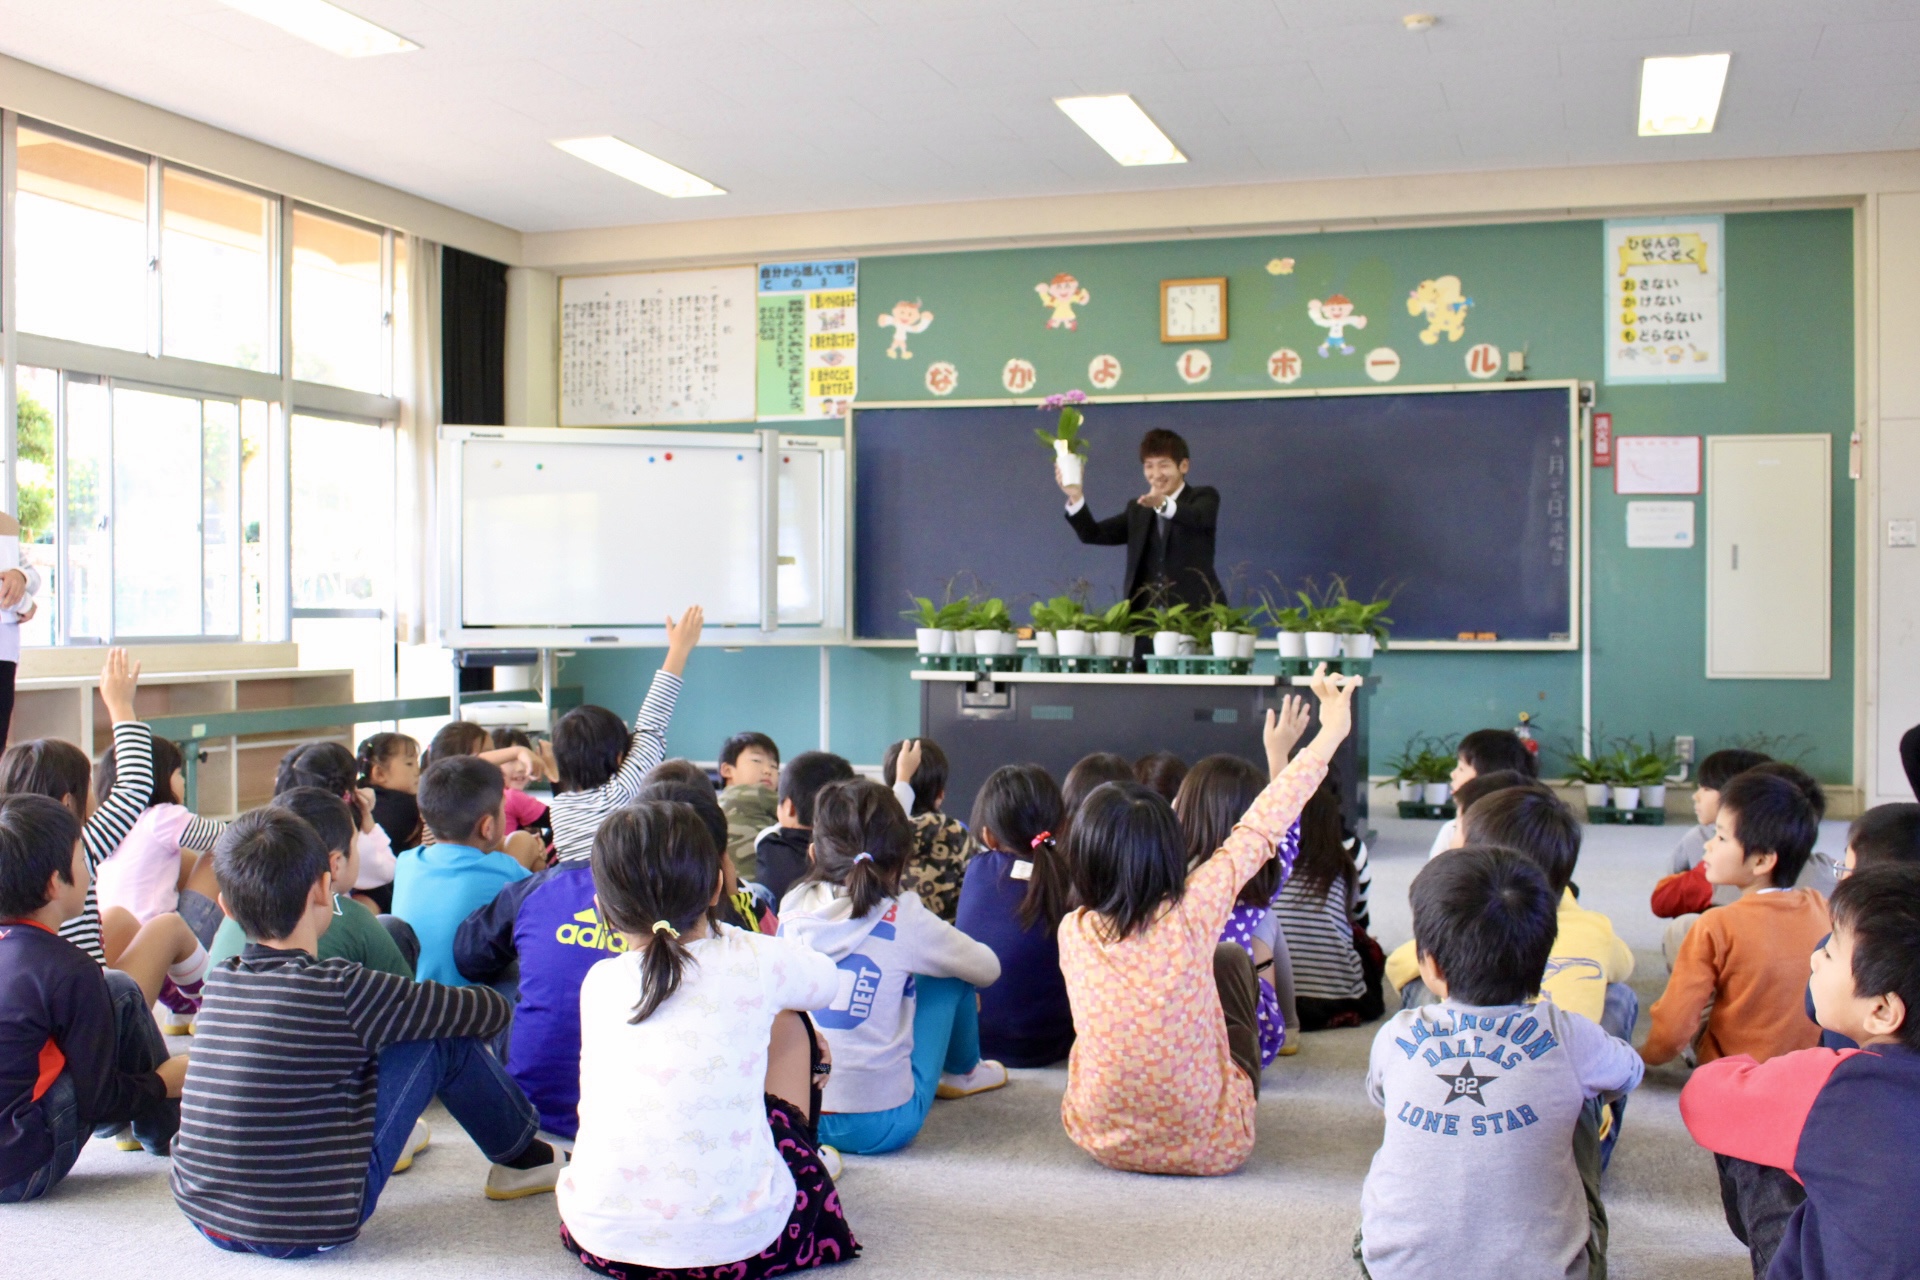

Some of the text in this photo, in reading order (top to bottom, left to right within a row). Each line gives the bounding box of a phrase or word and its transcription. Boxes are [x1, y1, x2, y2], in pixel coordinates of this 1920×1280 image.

[1627, 236, 1680, 250] ひなんの
[1642, 249, 1696, 262] やくそく
[1623, 278, 1679, 291] おさない
[1623, 295, 1682, 308] かけない
[1623, 311, 1703, 325] しゃべらない
[1623, 329, 1690, 343] もどらない
[929, 347, 1496, 391] なかよしホール
[849, 967, 880, 1018] DEPT
[1422, 1036, 1522, 1070] DALLAS
[1454, 1077, 1478, 1094] 82
[1397, 1101, 1539, 1136] LONE STAR
